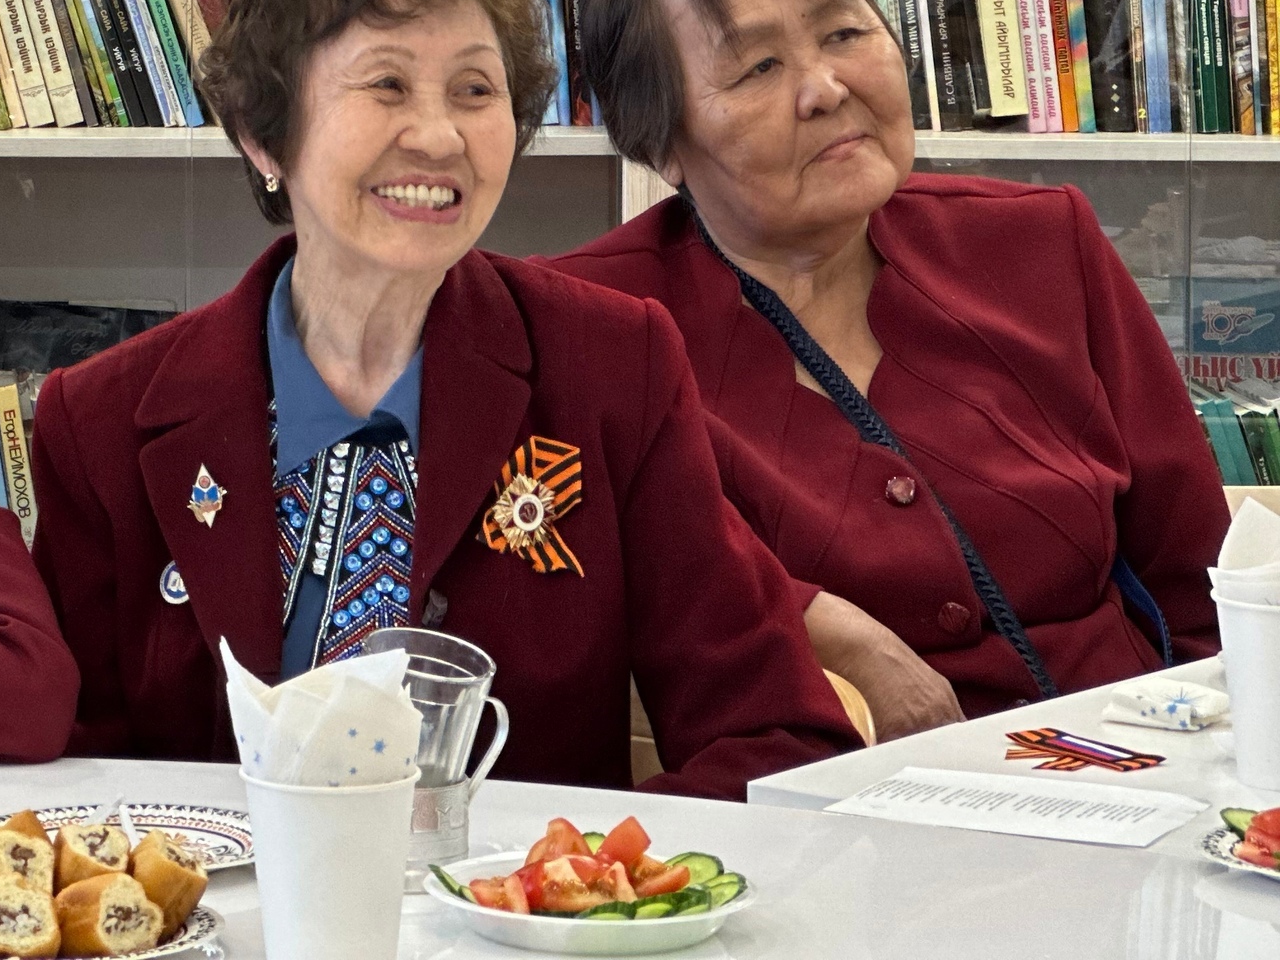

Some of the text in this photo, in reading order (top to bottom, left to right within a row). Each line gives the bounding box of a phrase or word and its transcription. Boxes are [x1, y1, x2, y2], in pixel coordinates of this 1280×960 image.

[1212, 0, 1221, 37] Тарасович
[112, 46, 126, 71] УЙГУР
[128, 47, 143, 72] УЙГУР
[994, 20, 1016, 99] АЙЫМНЬЫЛАР
[1202, 36, 1210, 65] СИВЦЕВ
[1214, 37, 1223, 66] СИВЦЕВ
[941, 51, 956, 104] В.САВВИН
